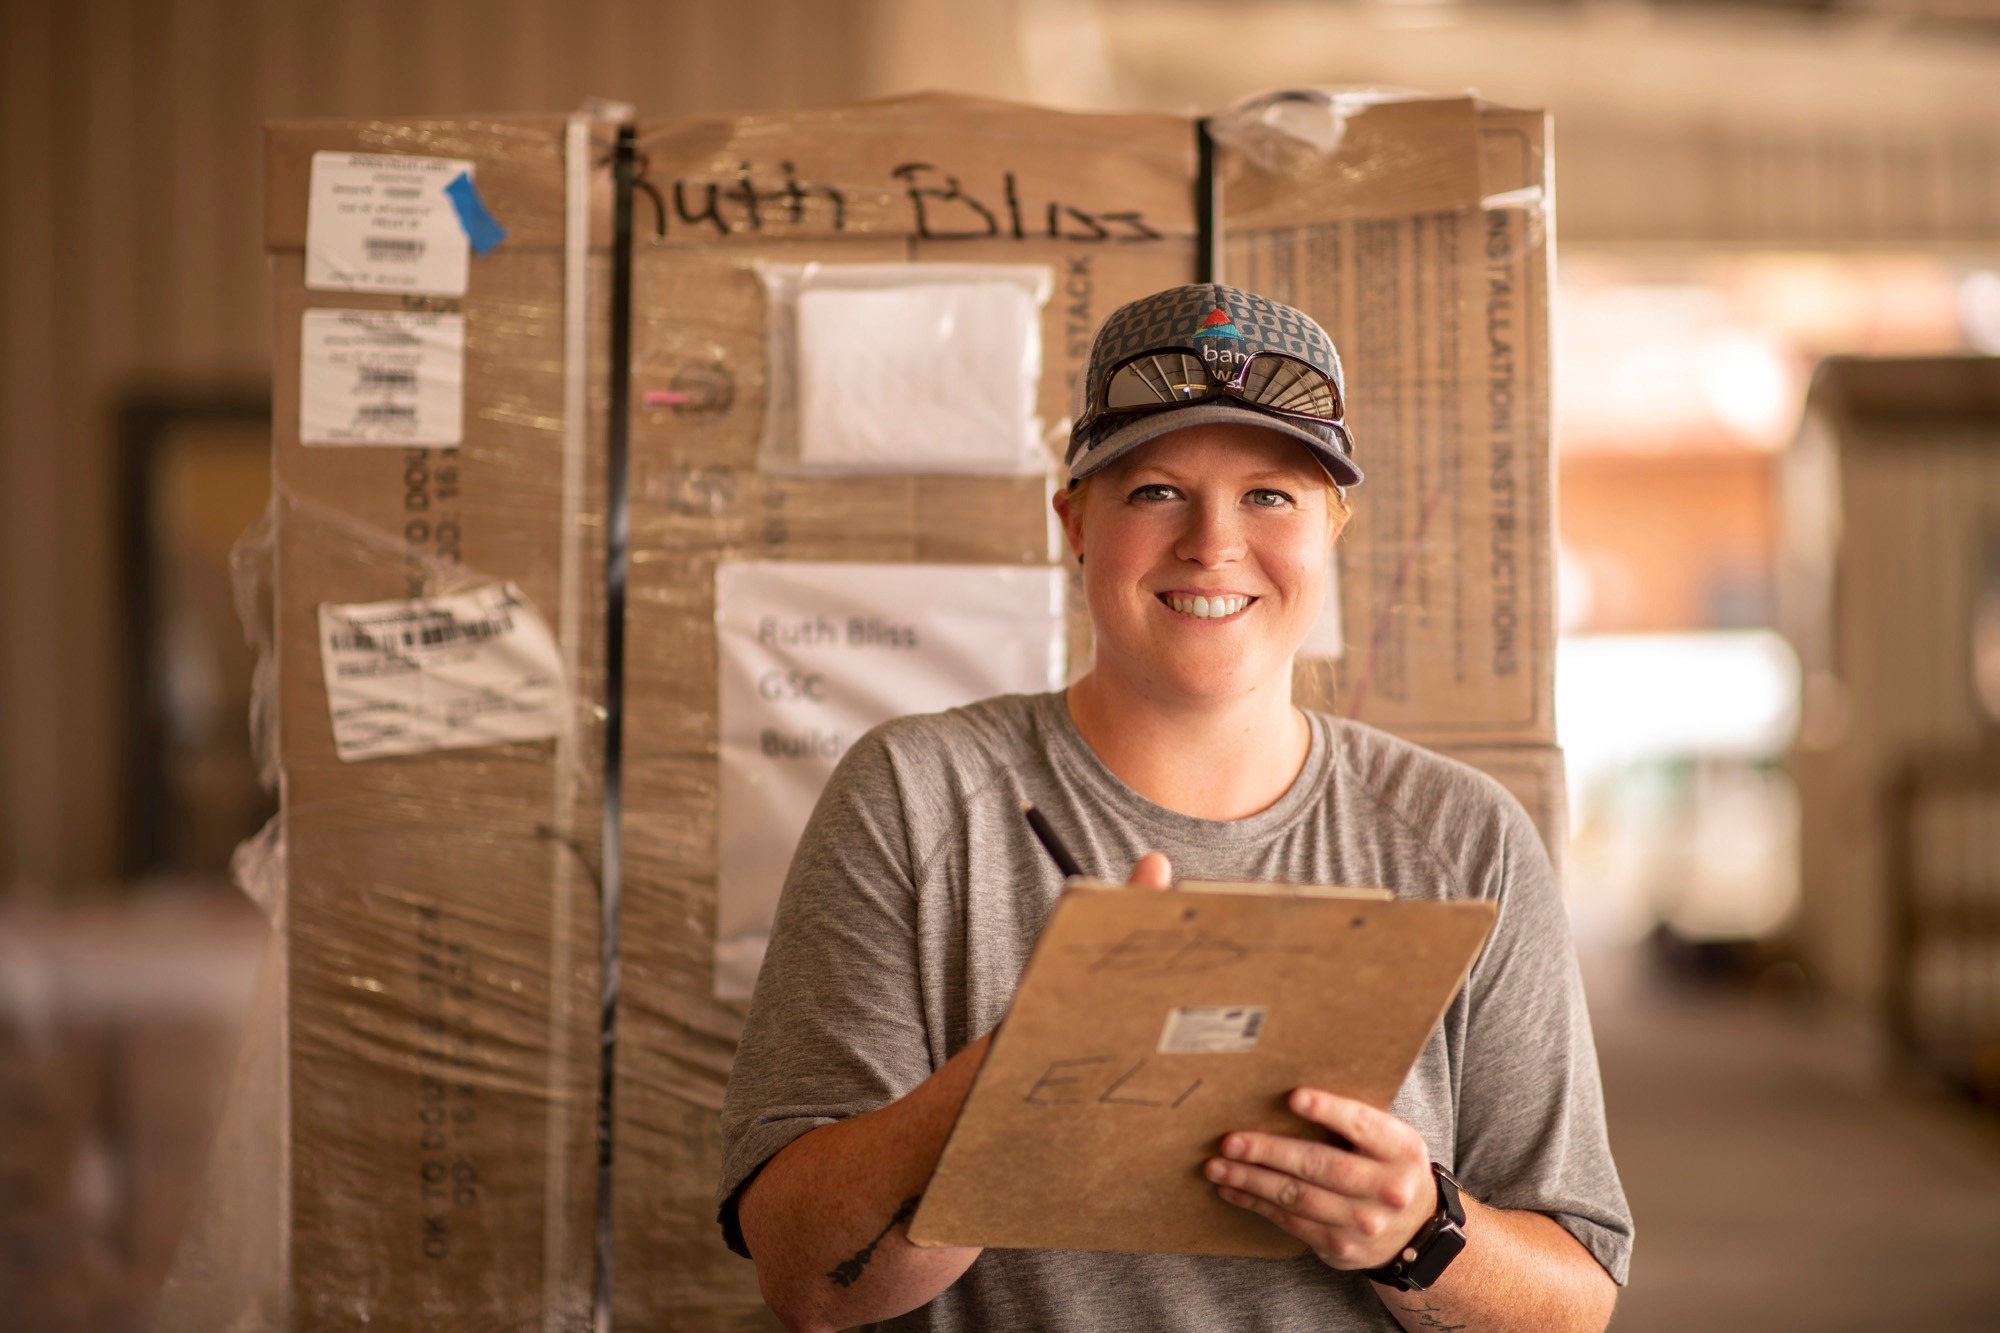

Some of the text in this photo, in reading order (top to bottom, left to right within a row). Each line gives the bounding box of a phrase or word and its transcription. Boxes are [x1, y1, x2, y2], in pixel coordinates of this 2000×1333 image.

[1065, 255, 1091, 359] STACK
[1489, 441, 1518, 677] INSTRUCTIONS
[759, 613, 918, 649] Ruth Bliss
